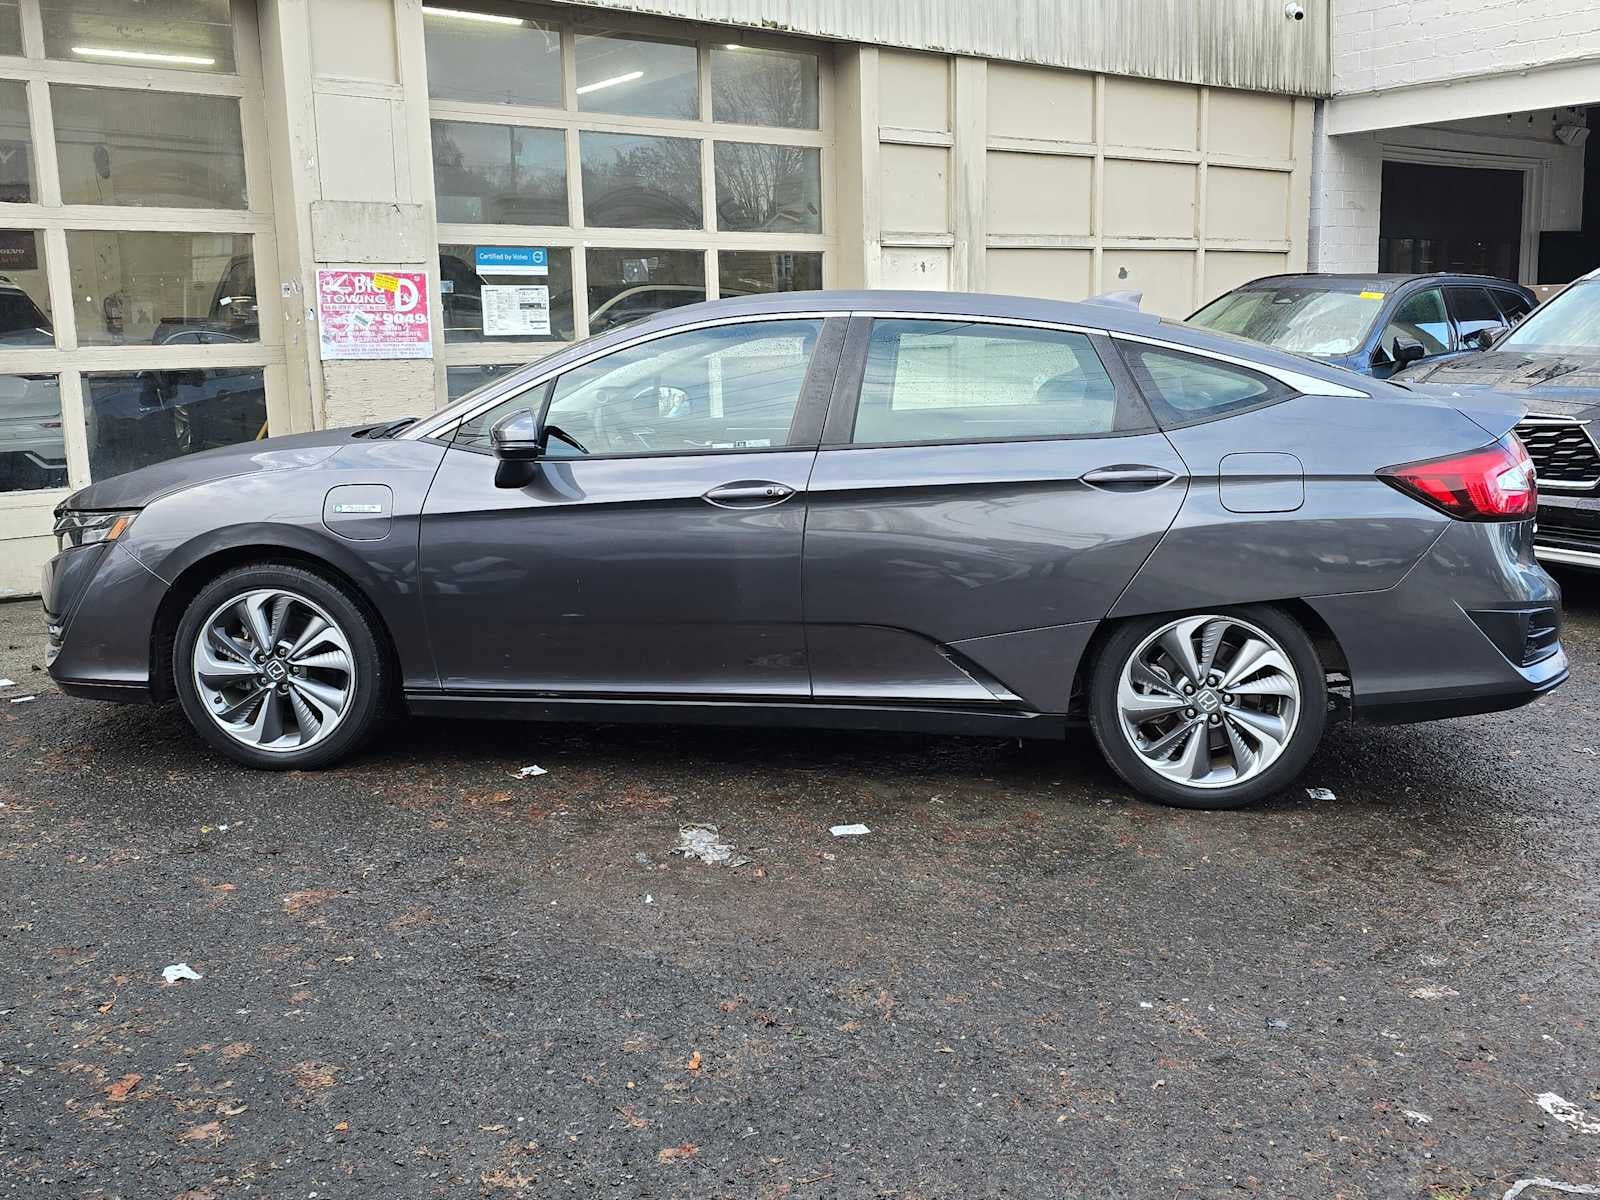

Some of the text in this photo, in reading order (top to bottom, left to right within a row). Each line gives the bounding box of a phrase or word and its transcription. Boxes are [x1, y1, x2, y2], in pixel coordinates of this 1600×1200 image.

[480, 252, 504, 260] Certified
[505, 254, 512, 262] by
[326, 294, 385, 304] TOWING
[395, 278, 419, 312] D
